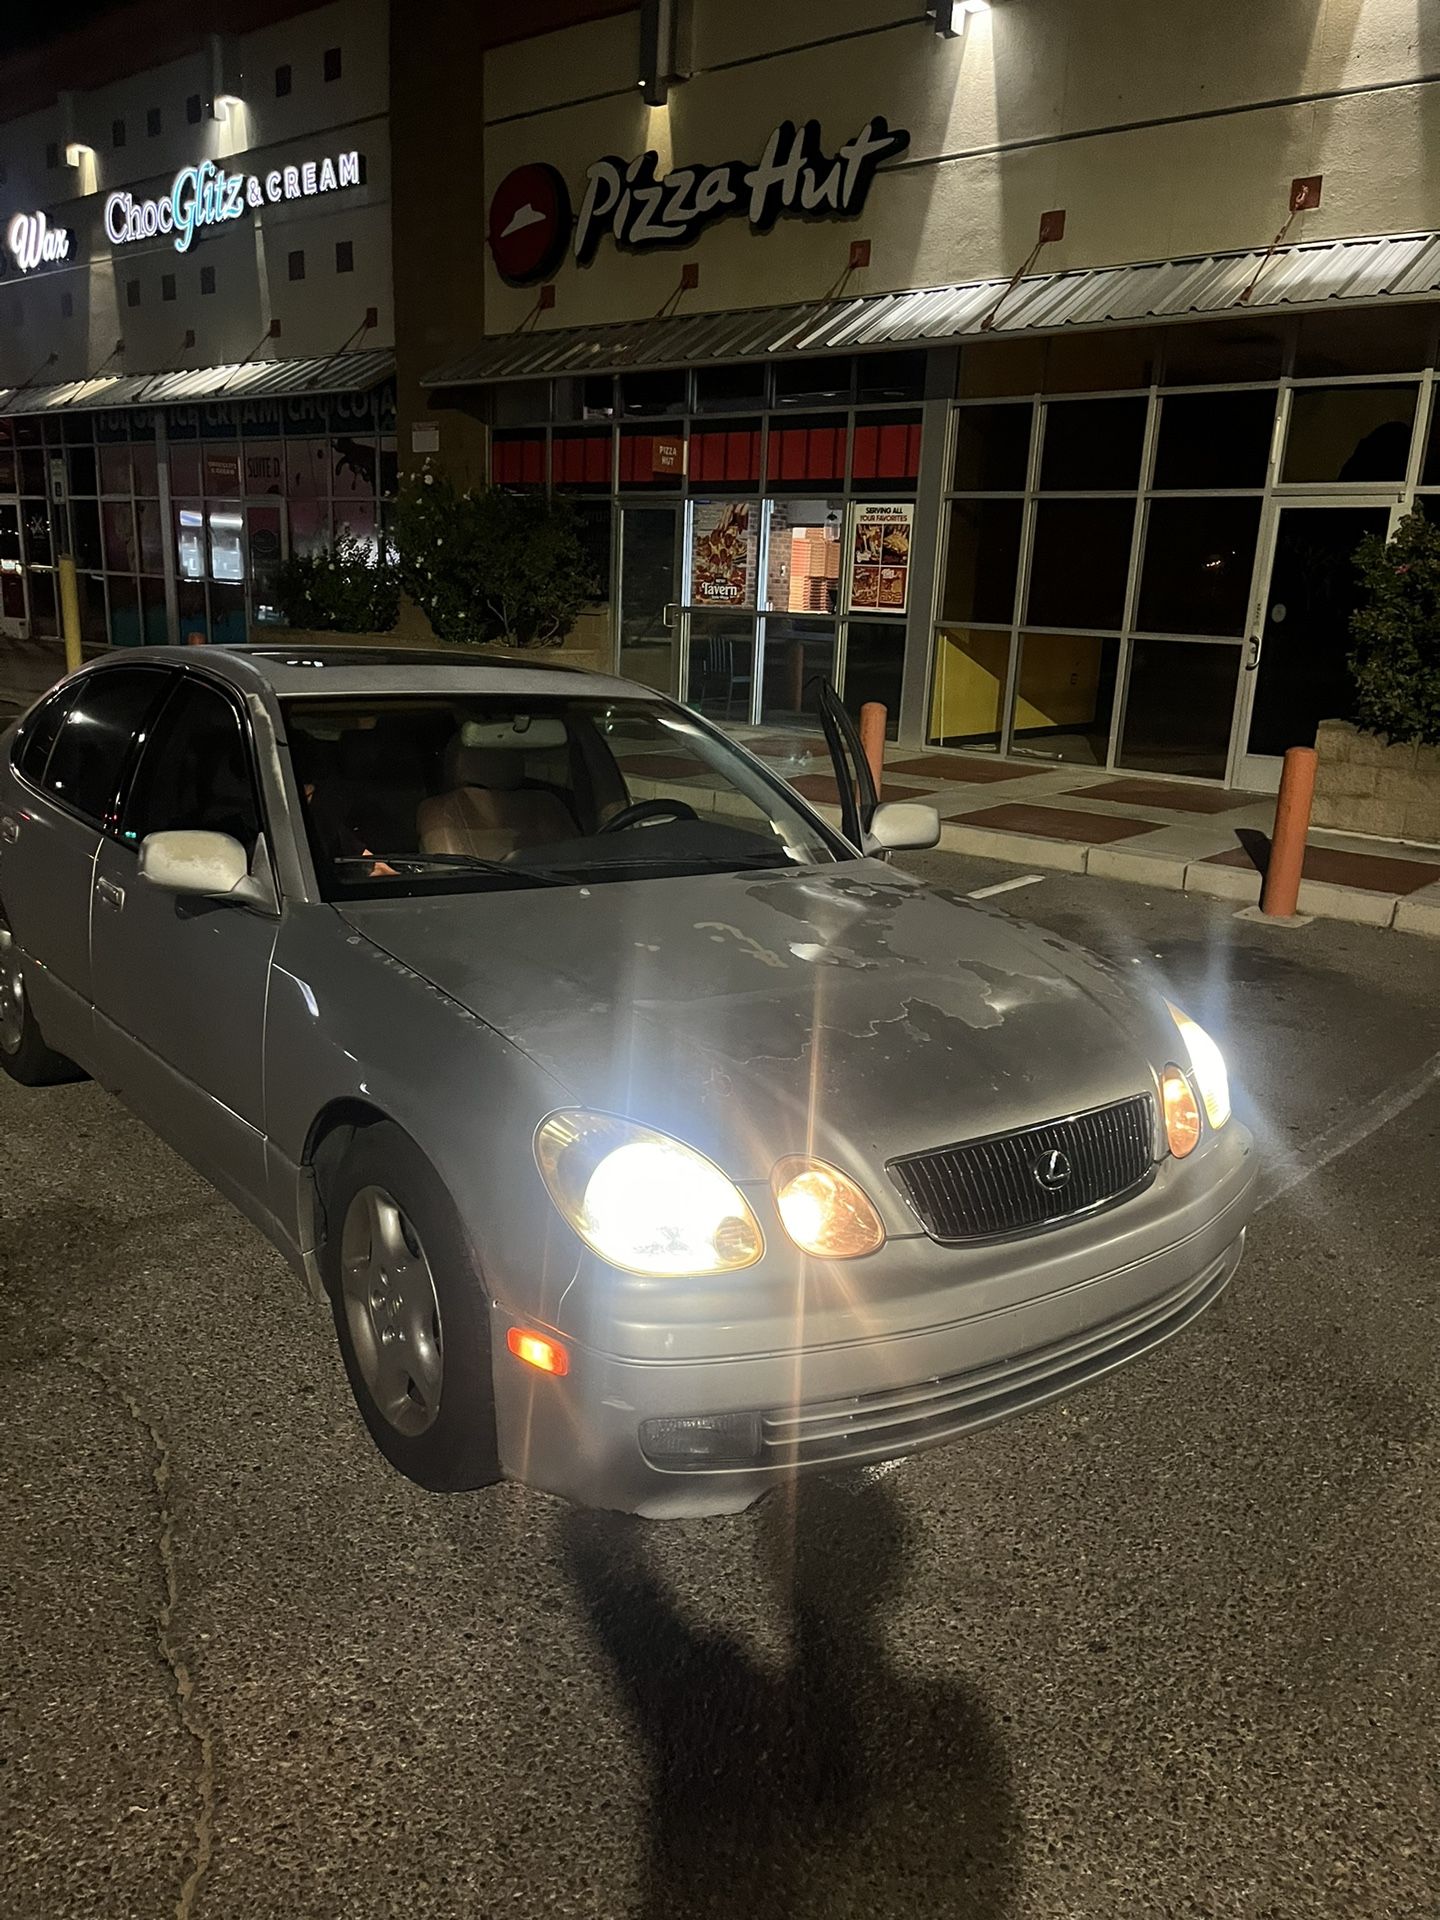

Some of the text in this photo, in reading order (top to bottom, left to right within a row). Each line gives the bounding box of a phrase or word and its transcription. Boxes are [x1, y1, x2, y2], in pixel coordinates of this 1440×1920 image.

[575, 122, 896, 258] Pizza Hut
[105, 151, 361, 252] ChocGlitz & CREAM
[10, 209, 70, 272] Wax
[659, 445, 677, 456] PIZZA
[247, 457, 281, 478] SUITE D
[860, 514, 908, 522] YOUR FAVORITES
[701, 582, 738, 596] Tavern
